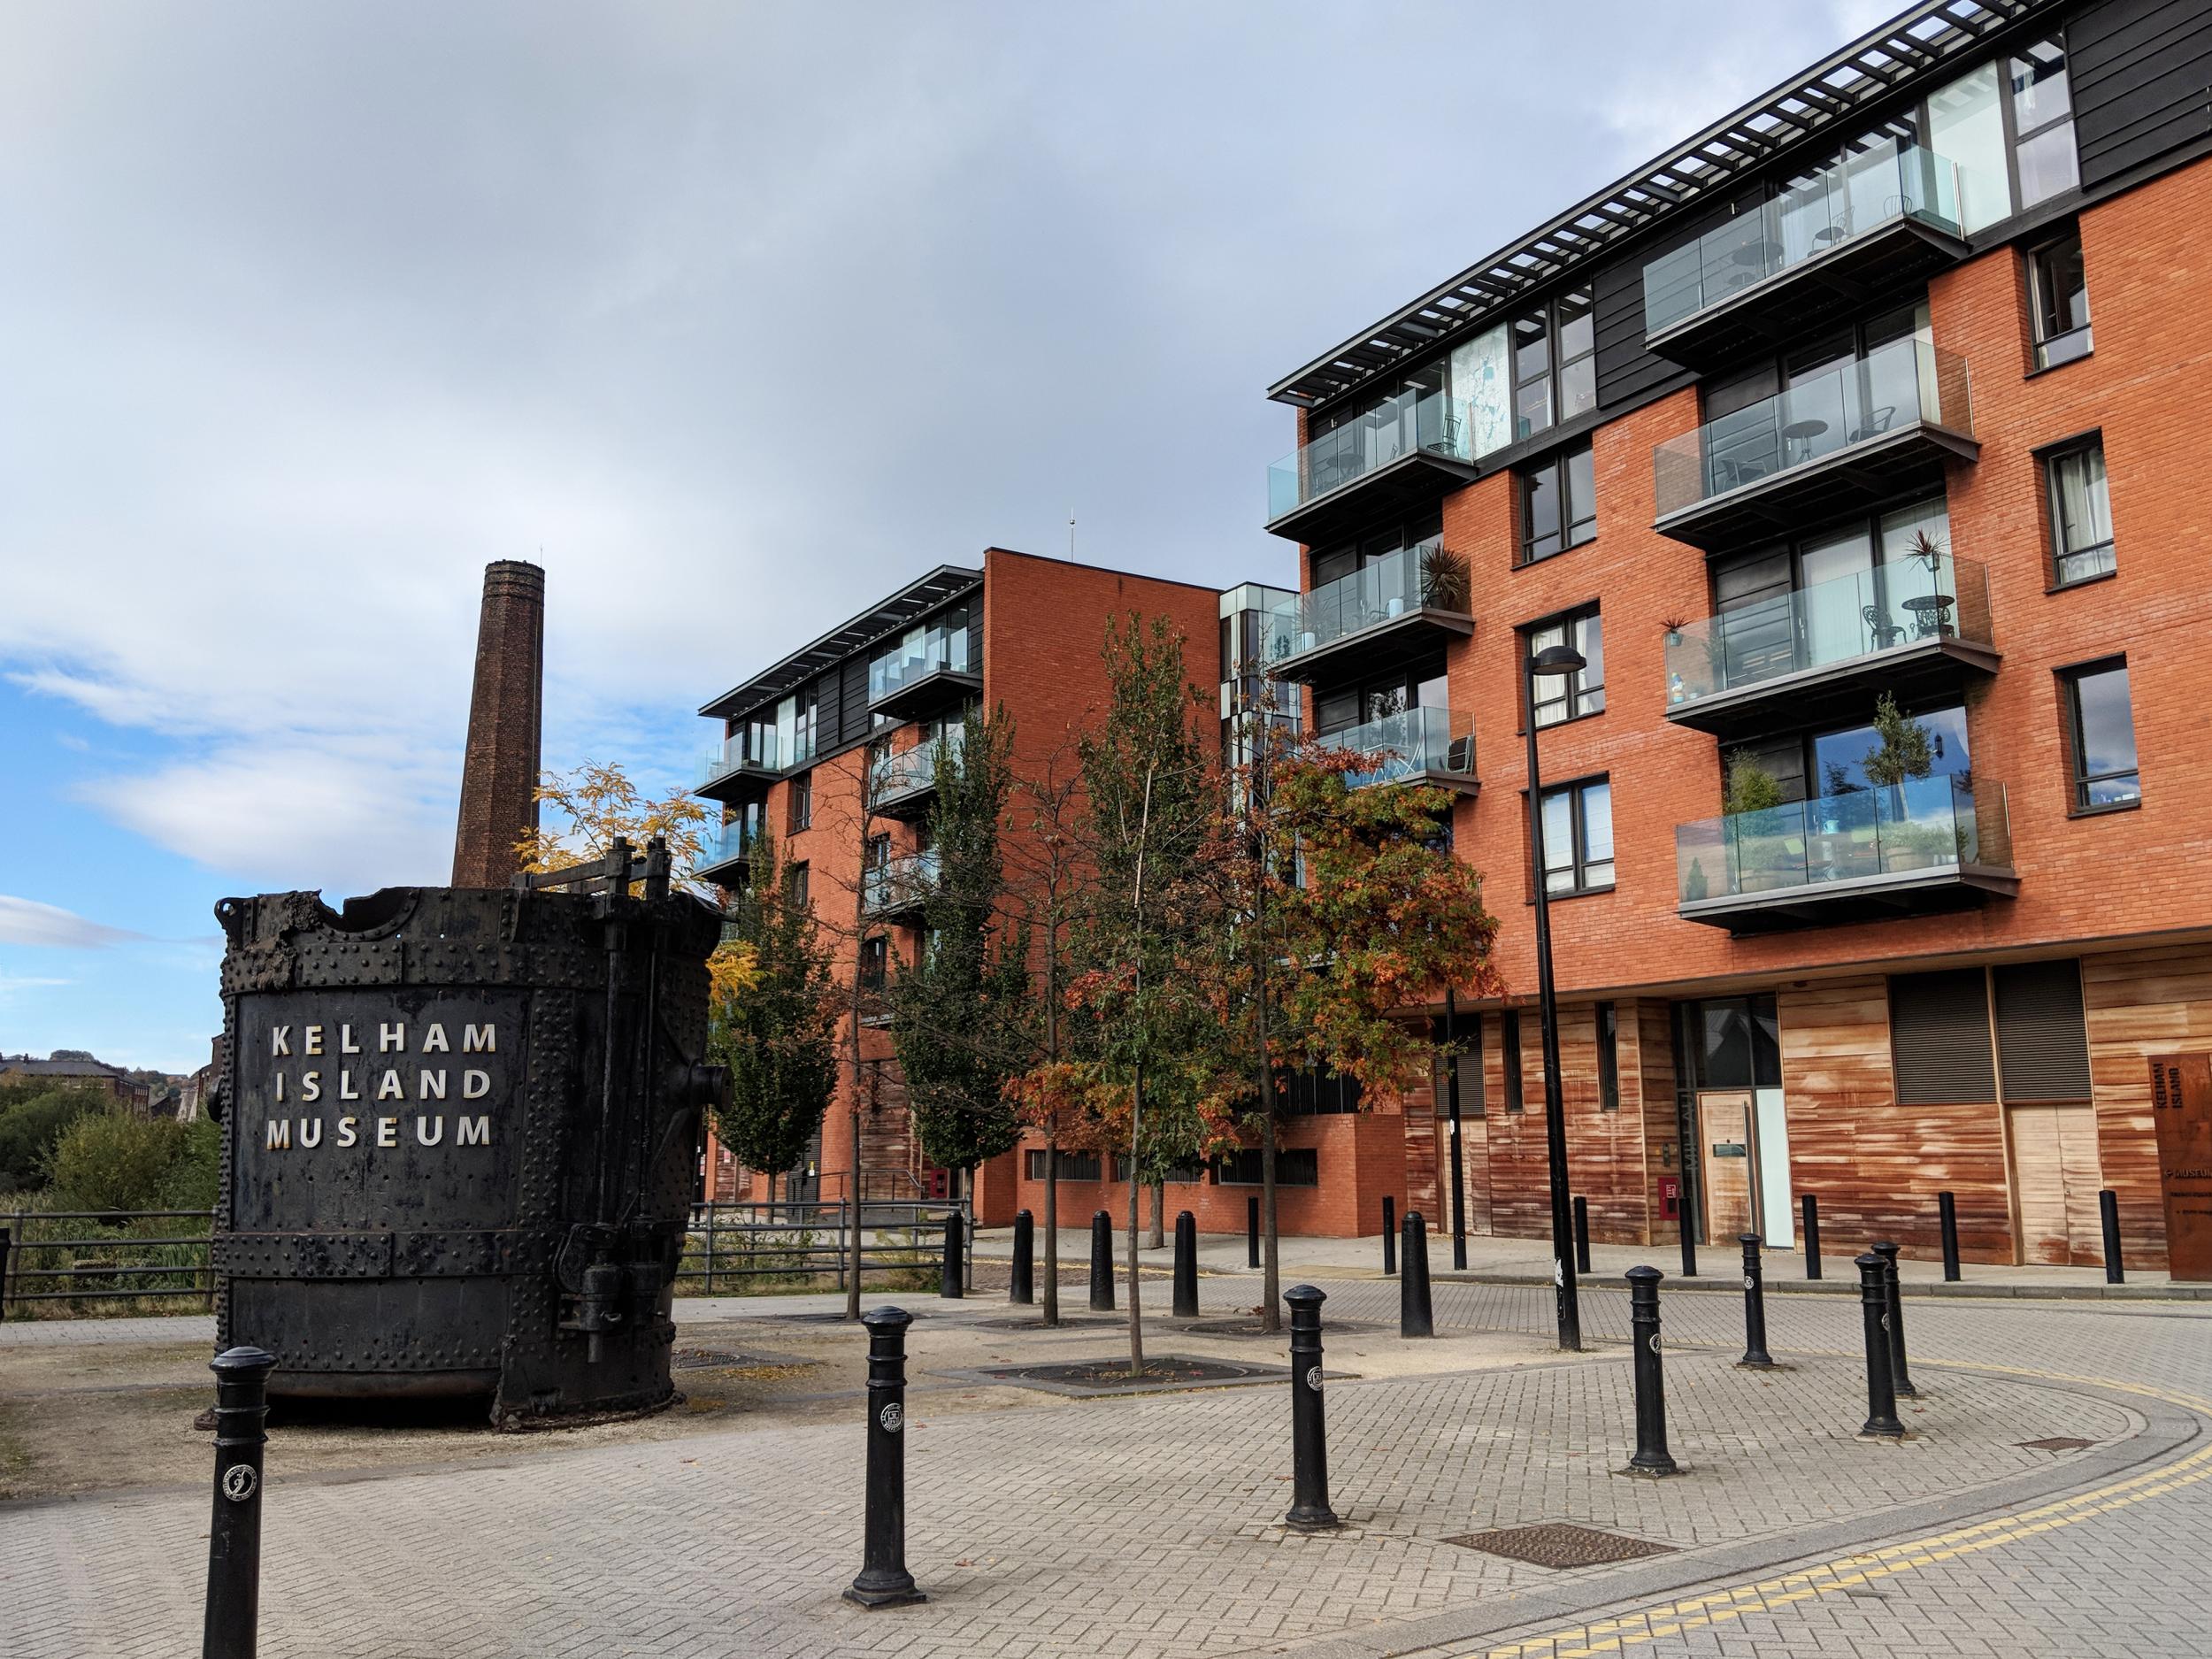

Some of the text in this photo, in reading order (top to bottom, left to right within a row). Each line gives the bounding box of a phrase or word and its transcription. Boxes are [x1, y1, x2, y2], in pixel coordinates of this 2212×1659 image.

[273, 1023, 495, 1056] KELHAM
[276, 1069, 491, 1102] ISLAND
[2153, 1064, 2167, 1108] KELHAM
[2169, 1068, 2182, 1108] ISLAND
[267, 1116, 490, 1150] MUSEUM
